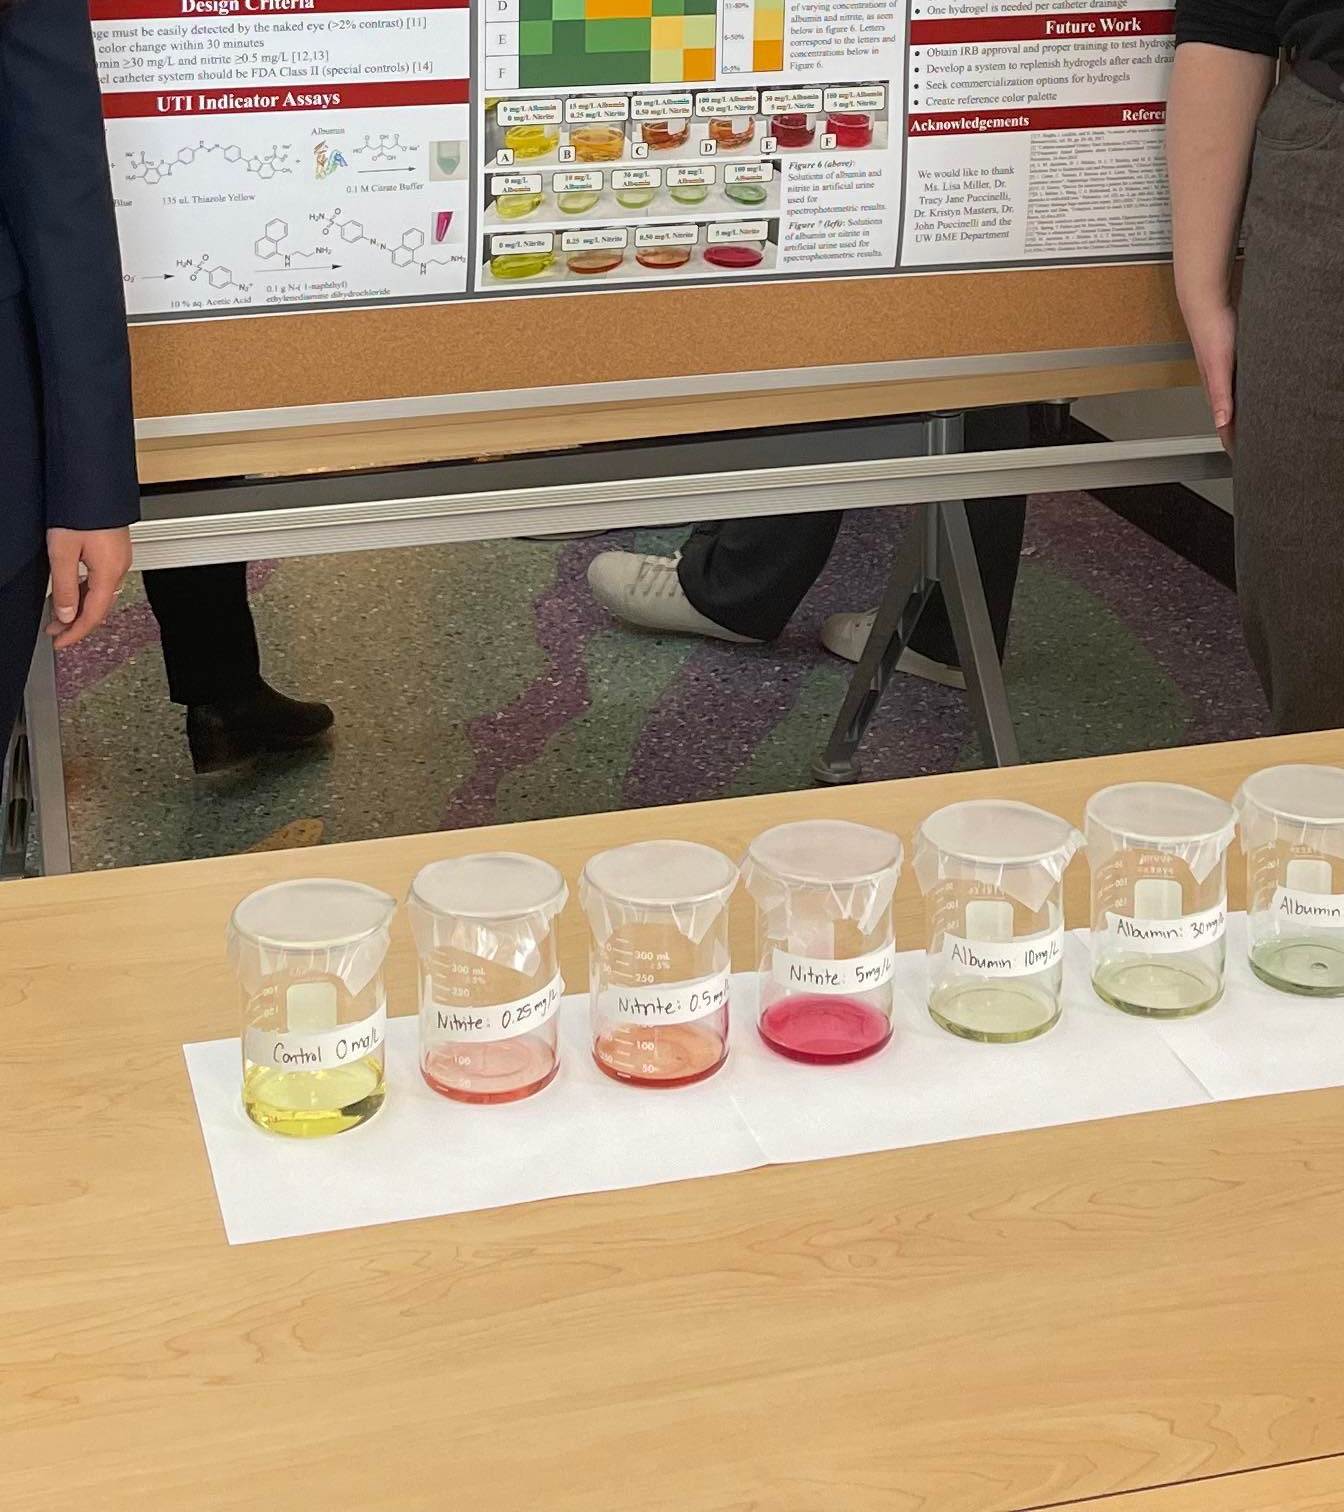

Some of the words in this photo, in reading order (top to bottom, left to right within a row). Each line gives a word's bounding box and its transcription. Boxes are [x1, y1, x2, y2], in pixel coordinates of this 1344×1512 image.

[1045, 20, 1096, 34] Future
[1099, 17, 1141, 31] Work
[98, 42, 126, 53] color
[127, 42, 167, 54] change
[169, 40, 204, 50] within
[206, 38, 221, 49] 30
[222, 39, 265, 48] minutes
[925, 79, 947, 90] Seek
[949, 77, 1034, 88] commercialization
[1035, 76, 1069, 87] options
[1070, 73, 1084, 83] for
[1085, 72, 1131, 84] hydrogels
[156, 95, 192, 111] UTI
[198, 94, 279, 109] Indicator
[282, 92, 341, 111] Assays
[909, 117, 1031, 131] Acknowledgements
[917, 169, 931, 179] We
[933, 168, 961, 178] would
[962, 167, 978, 177] like
[980, 168, 990, 176] to
[990, 166, 1016, 175] thank
[634, 952, 653, 960] 300
[635, 973, 654, 982] 250
[273, 1042, 322, 1065] Control
